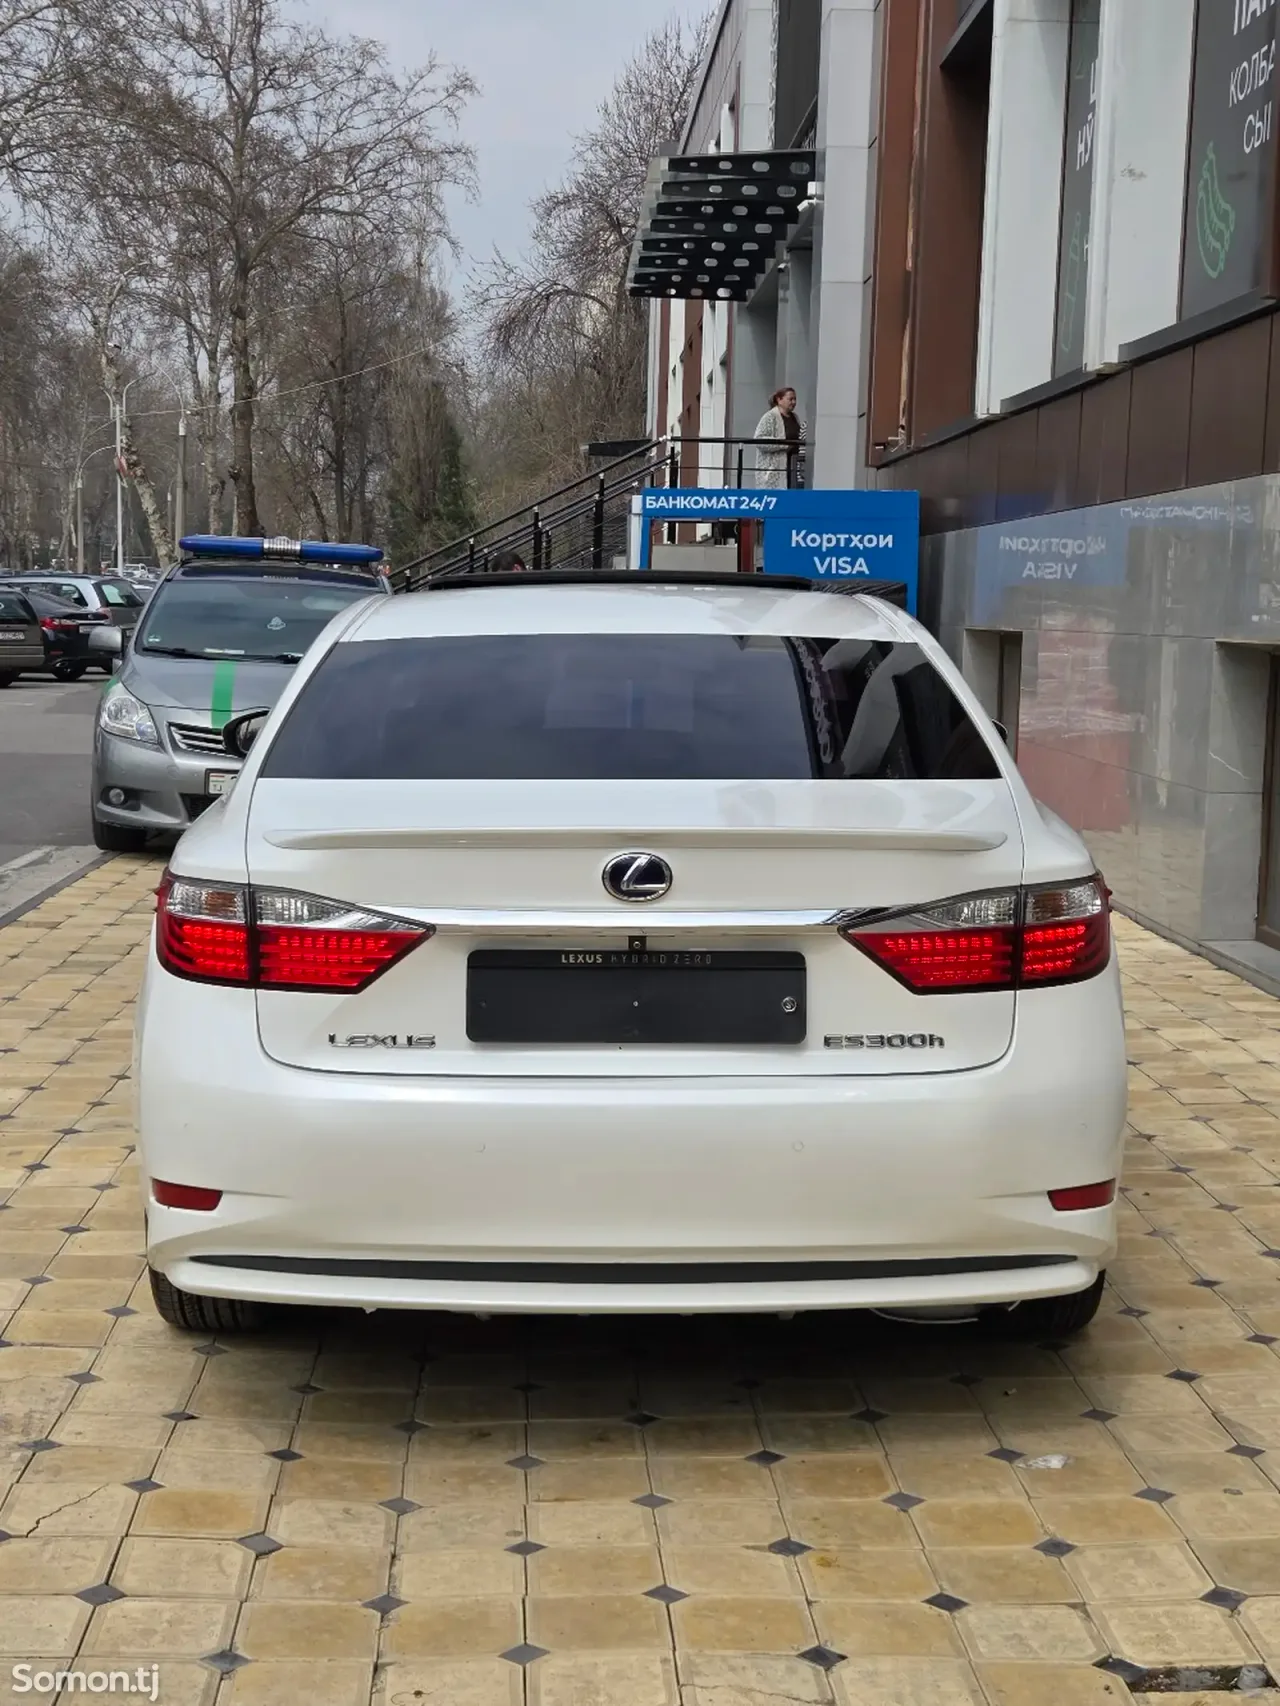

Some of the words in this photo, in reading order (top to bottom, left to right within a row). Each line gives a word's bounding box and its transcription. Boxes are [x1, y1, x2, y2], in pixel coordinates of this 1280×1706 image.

[645, 496, 738, 509] БАНКОМАТ
[739, 495, 777, 511] 24/7
[791, 529, 893, 552] Кортҳои
[813, 556, 870, 575] VISA
[561, 954, 603, 964] LEXUS
[611, 954, 667, 964] HYBRID
[673, 954, 712, 965] ZERO
[328, 1033, 436, 1049] LEXUS
[823, 1033, 945, 1049] ES300h
